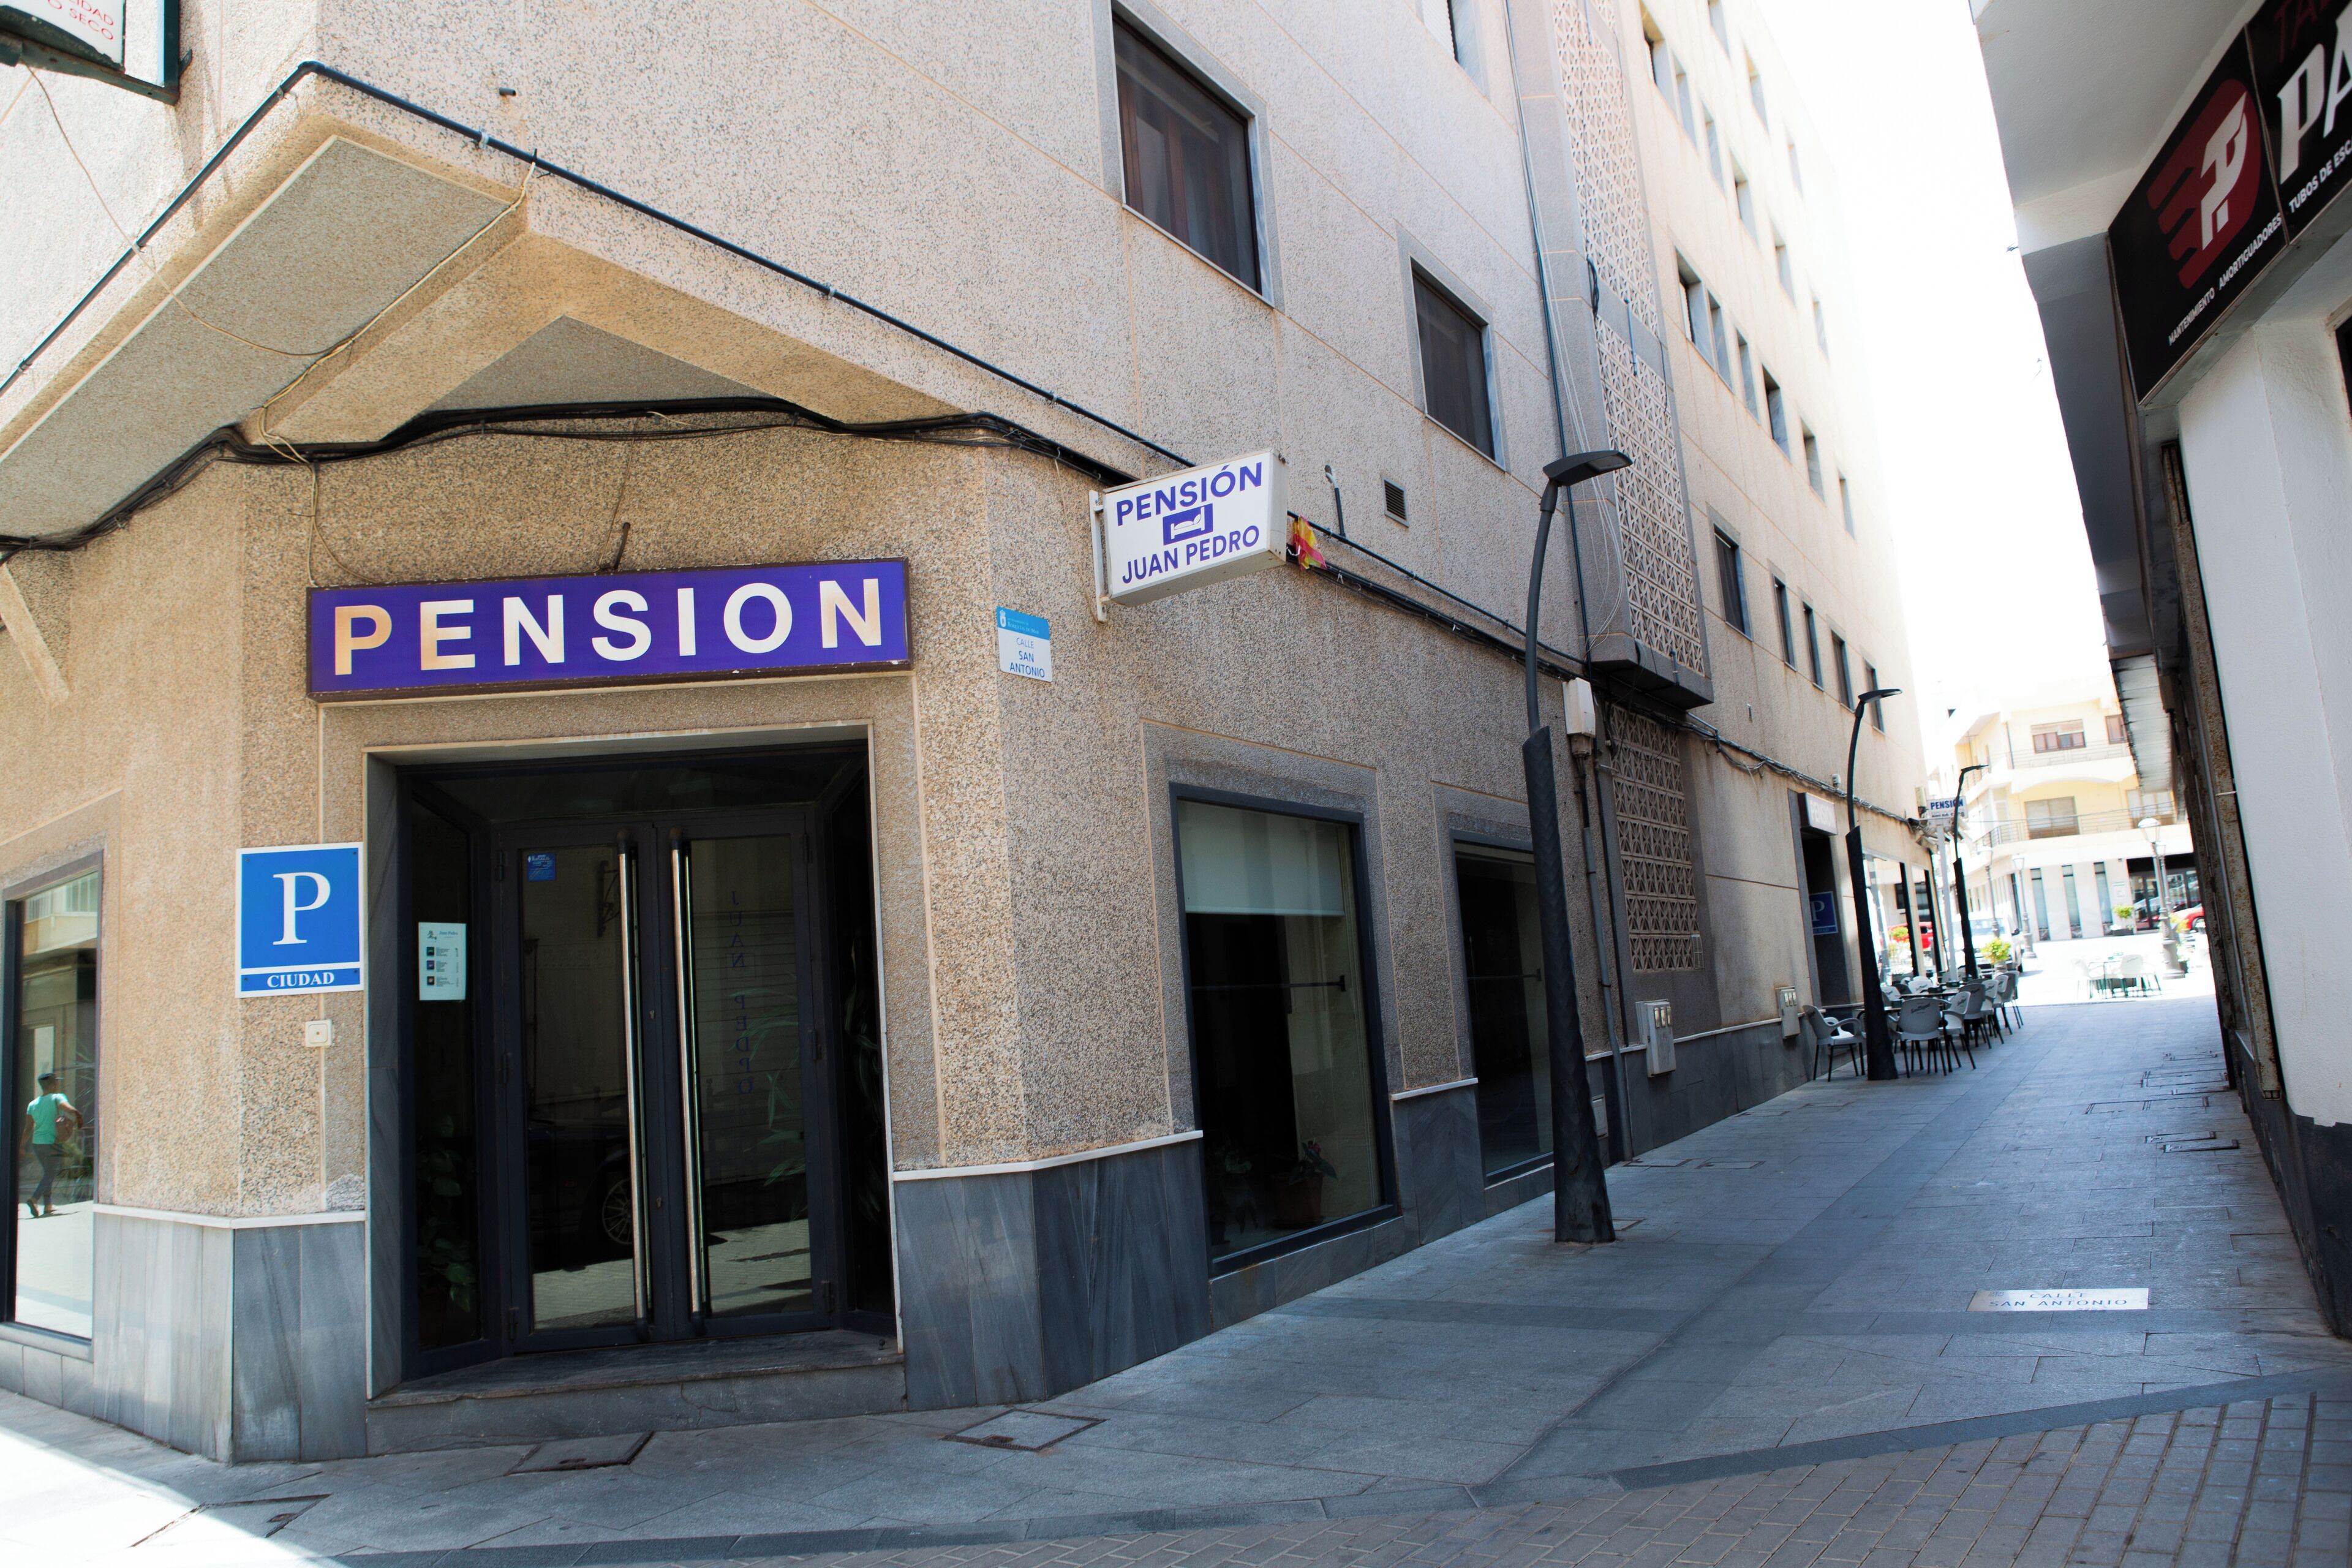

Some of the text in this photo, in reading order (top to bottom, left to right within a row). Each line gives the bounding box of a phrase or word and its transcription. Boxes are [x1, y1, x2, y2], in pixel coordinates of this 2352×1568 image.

[69, 8, 113, 40] SECO
[2168, 135, 2352, 346] MANTENIMIENTO AMORTIGUADORES TUBOS DE ESC
[1116, 461, 1262, 527] PENSIÓN
[1121, 525, 1260, 584] JUAN PEDRO
[334, 577, 883, 676] PENSION
[1016, 637, 1035, 649] CALLE
[1019, 650, 1035, 663] SAN
[1009, 662, 1045, 678] ANTONIO
[271, 872, 331, 946] P
[1811, 900, 1825, 922] P
[266, 971, 335, 989] CIUDAD
